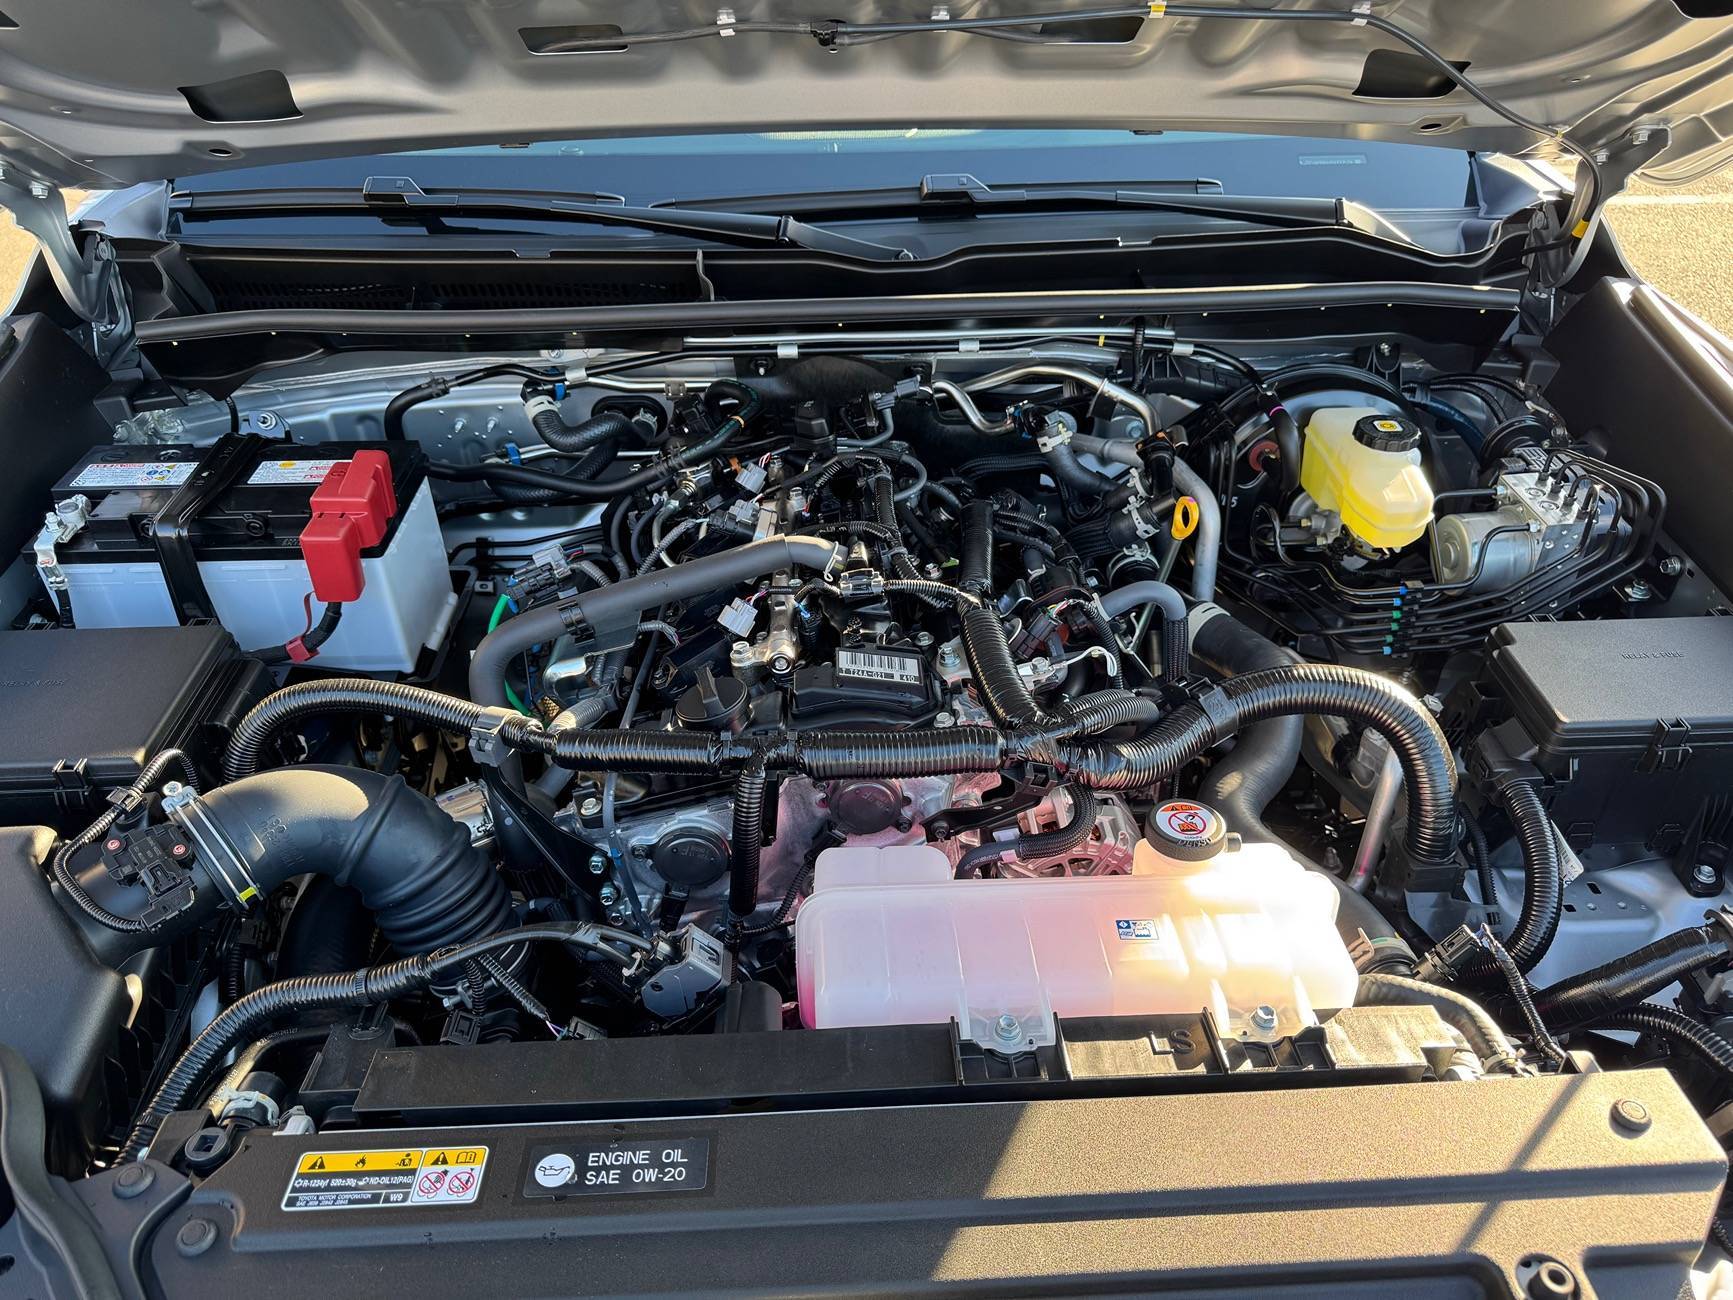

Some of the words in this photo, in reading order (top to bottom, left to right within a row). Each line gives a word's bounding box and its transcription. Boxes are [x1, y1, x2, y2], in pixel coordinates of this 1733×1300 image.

[587, 1150, 651, 1166] ENGINE
[661, 1148, 688, 1163] OIL
[584, 1169, 621, 1185] SAE
[631, 1166, 686, 1183] 0W-20
[389, 1193, 404, 1202] W9
